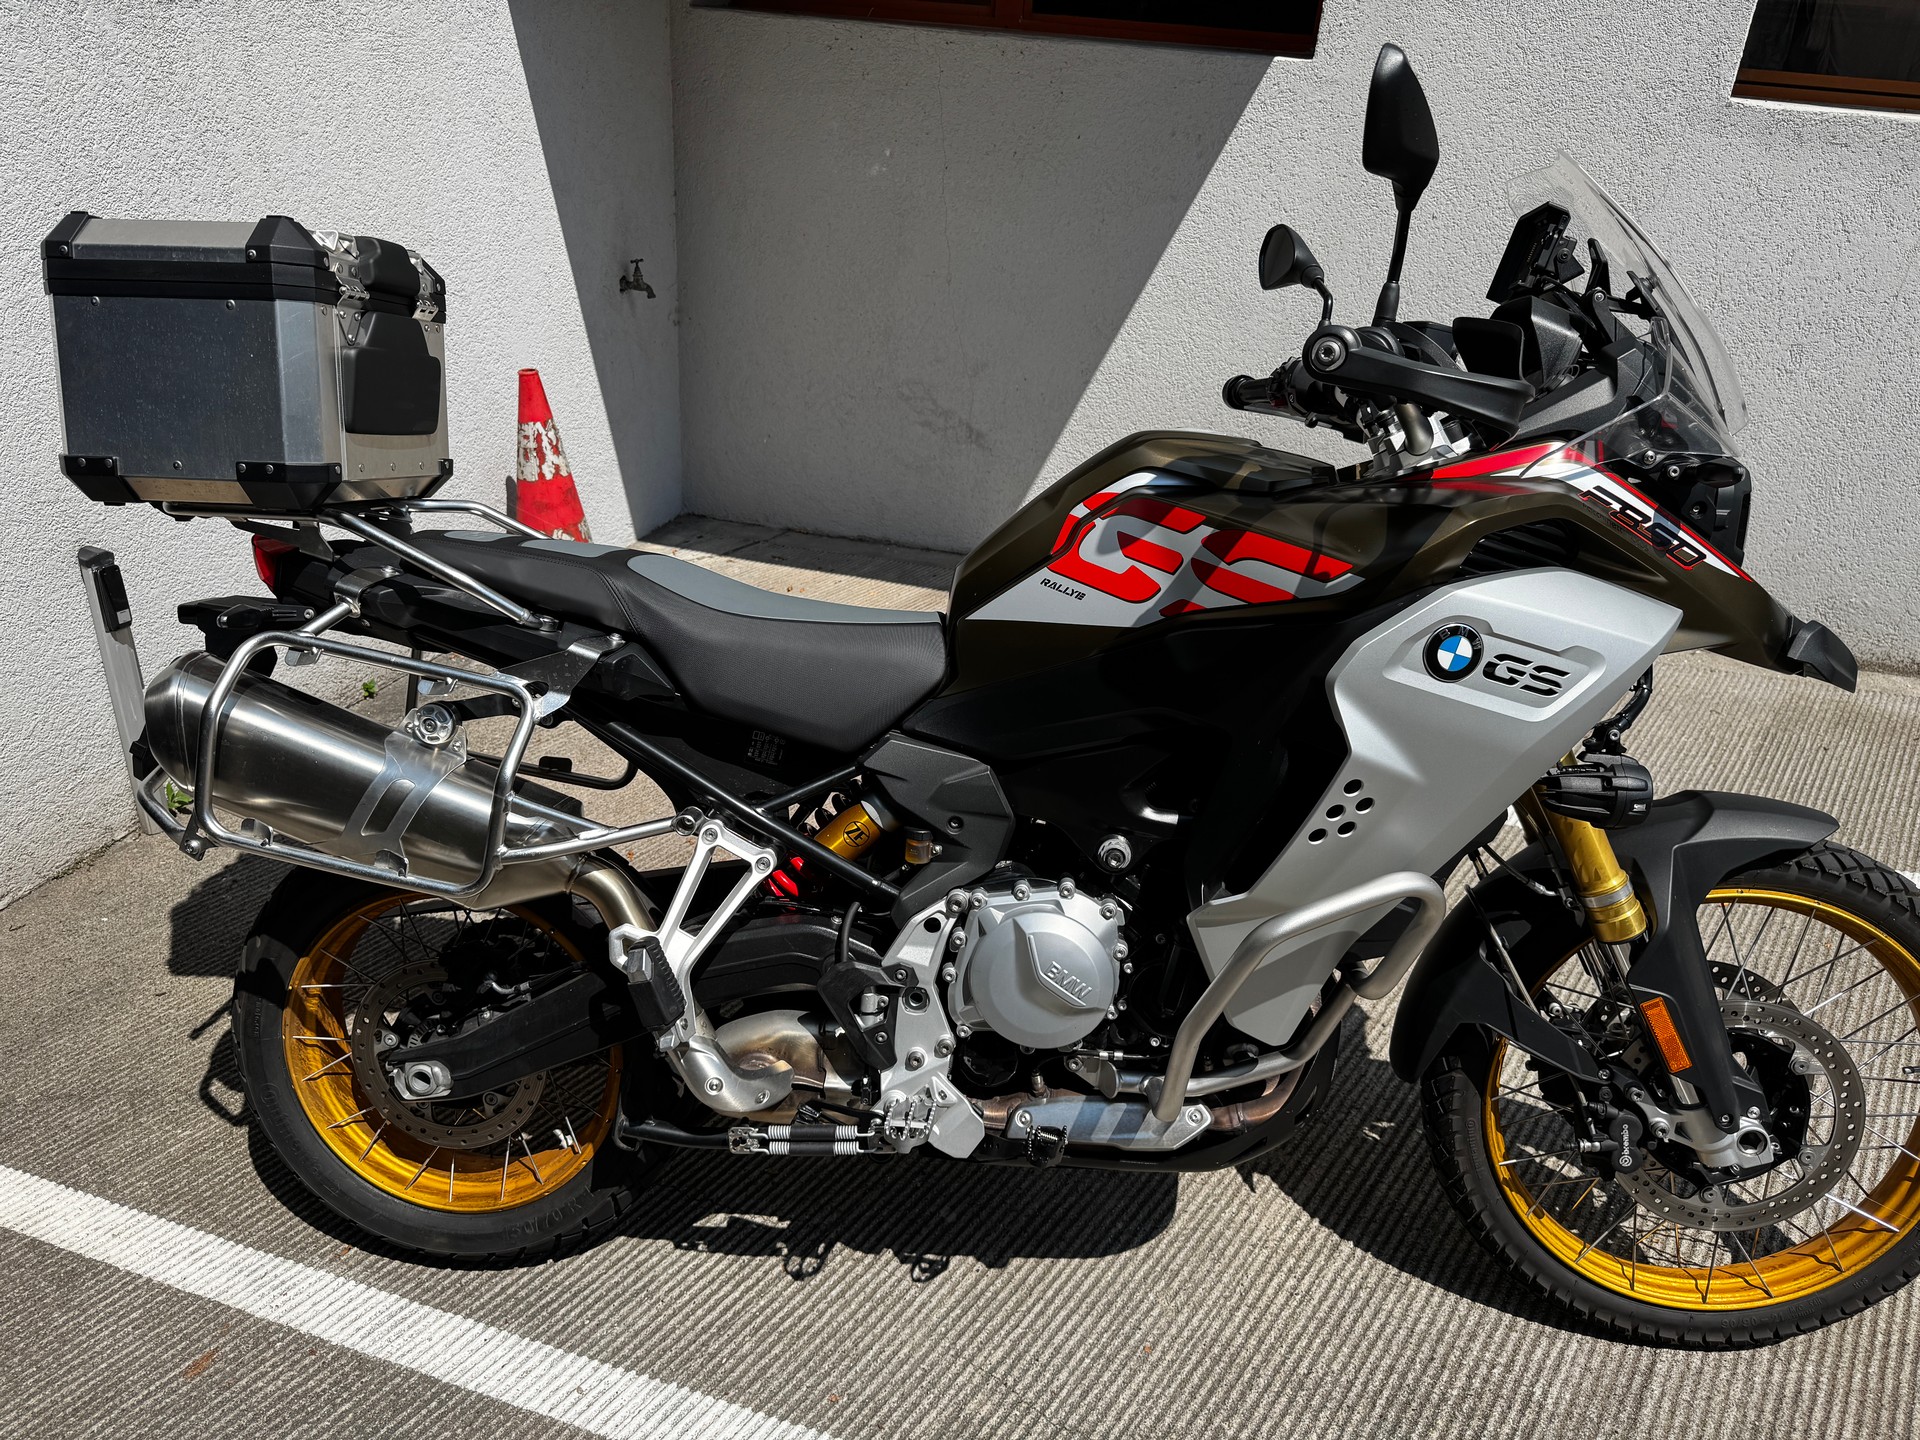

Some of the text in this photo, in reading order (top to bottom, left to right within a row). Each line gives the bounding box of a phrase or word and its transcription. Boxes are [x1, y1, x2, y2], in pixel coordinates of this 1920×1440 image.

[1577, 484, 1708, 571] F850
[1040, 577, 1087, 601] RALLYE
[1438, 624, 1483, 651] BMW
[1482, 653, 1572, 697] GS
[842, 820, 871, 848] ZF
[1043, 960, 1093, 1000] BMW
